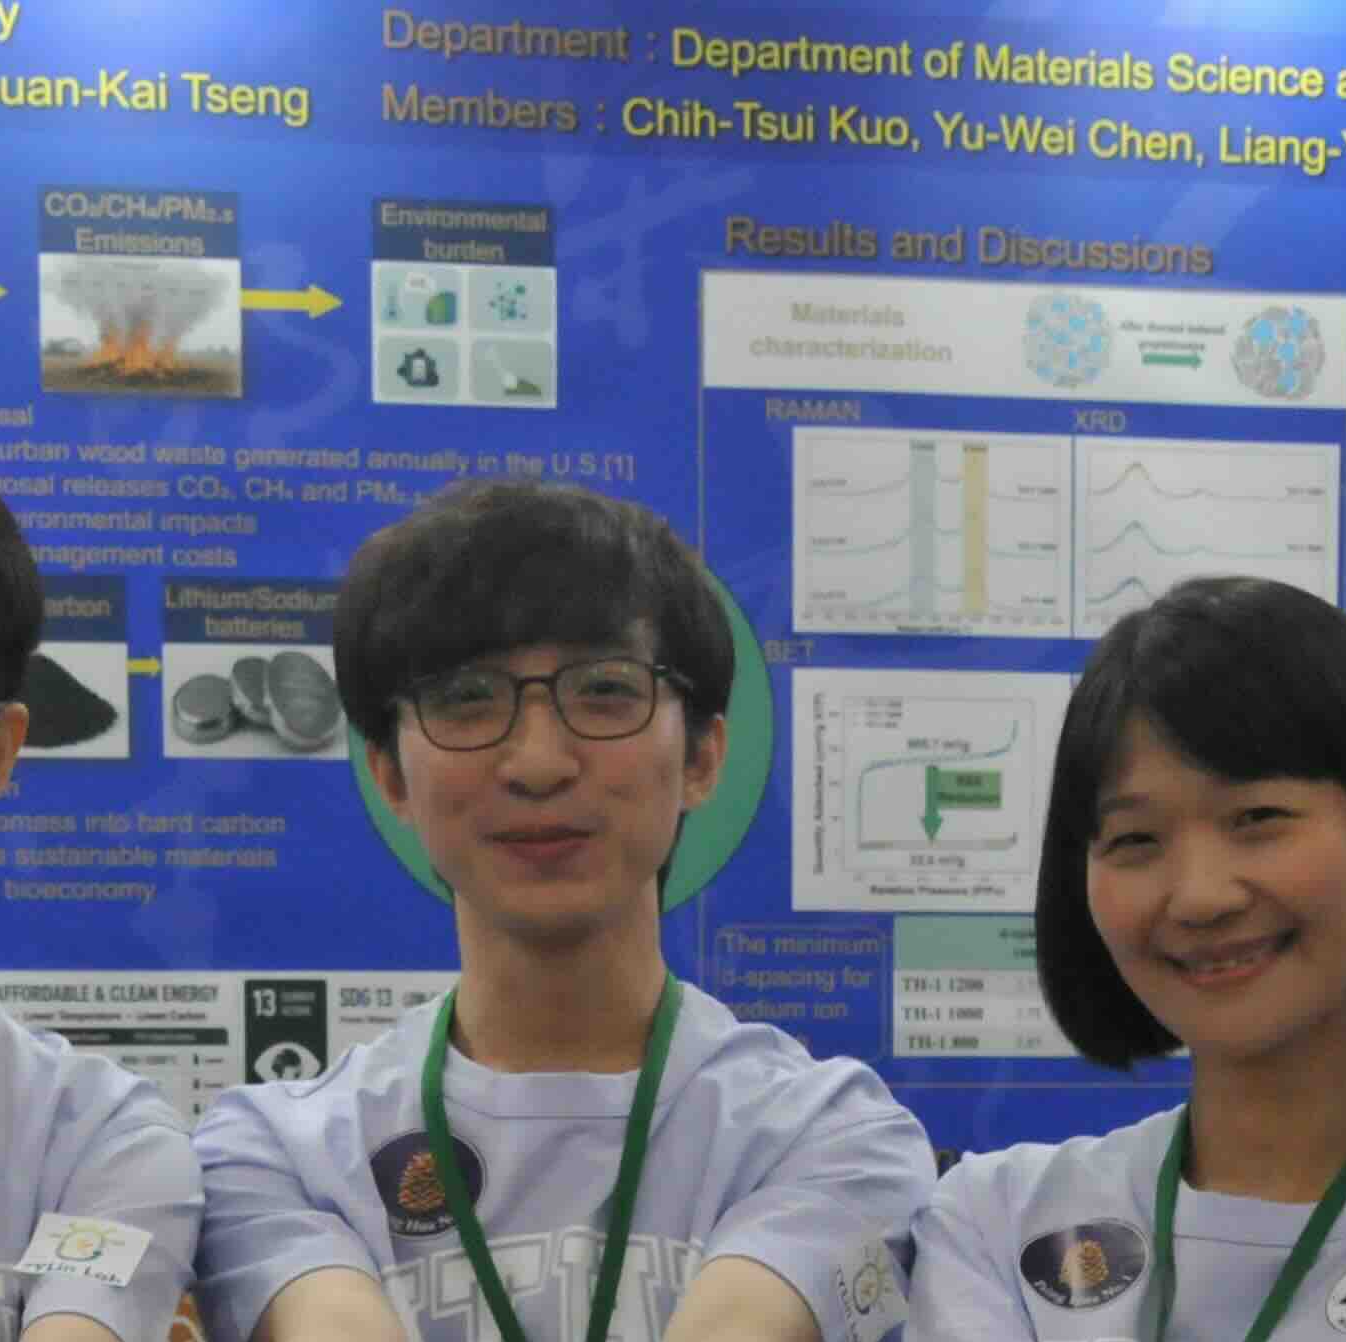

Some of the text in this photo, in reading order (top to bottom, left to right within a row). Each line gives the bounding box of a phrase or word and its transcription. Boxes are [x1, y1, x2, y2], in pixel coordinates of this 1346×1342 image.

[382, 9, 629, 61] Department
[672, 29, 912, 79] Department
[923, 41, 961, 79] of
[975, 44, 1154, 91] Materials
[1167, 55, 1324, 99] Science
[180, 72, 310, 126] Tseng
[382, 82, 578, 132] Members
[621, 97, 815, 143] Chih-Tsui
[829, 106, 921, 153] Kuo,
[934, 110, 1076, 155] Yu-Wei
[1089, 120, 1206, 166] Chen,
[381, 203, 548, 235] Environmental
[76, 228, 205, 257] Emissions
[422, 237, 506, 264] burden
[726, 217, 1213, 275] Results and Discussions
[791, 300, 905, 328] Materials
[749, 335, 953, 364] characterization
[765, 397, 862, 421] RAMAN
[1071, 409, 1127, 433] XRD
[77, 442, 147, 465] wood
[156, 445, 225, 466] waste
[234, 448, 361, 472] generated
[367, 451, 470, 475] annually
[476, 453, 500, 473] in
[506, 453, 544, 475] the
[62, 475, 349, 502] releases and
[161, 512, 259, 537] impacts
[172, 545, 239, 569] costs
[205, 616, 304, 640] batteries
[764, 640, 815, 664] BET
[84, 810, 287, 834] into hard carbon
[15, 845, 279, 868] sustainable materials
[4, 878, 157, 903] bioeconomy
[722, 933, 879, 955] The minimum
[107, 984, 157, 1002] CLEAN
[160, 984, 219, 1003] ENERGY
[254, 990, 276, 1017] 13
[339, 986, 372, 1008] SDG
